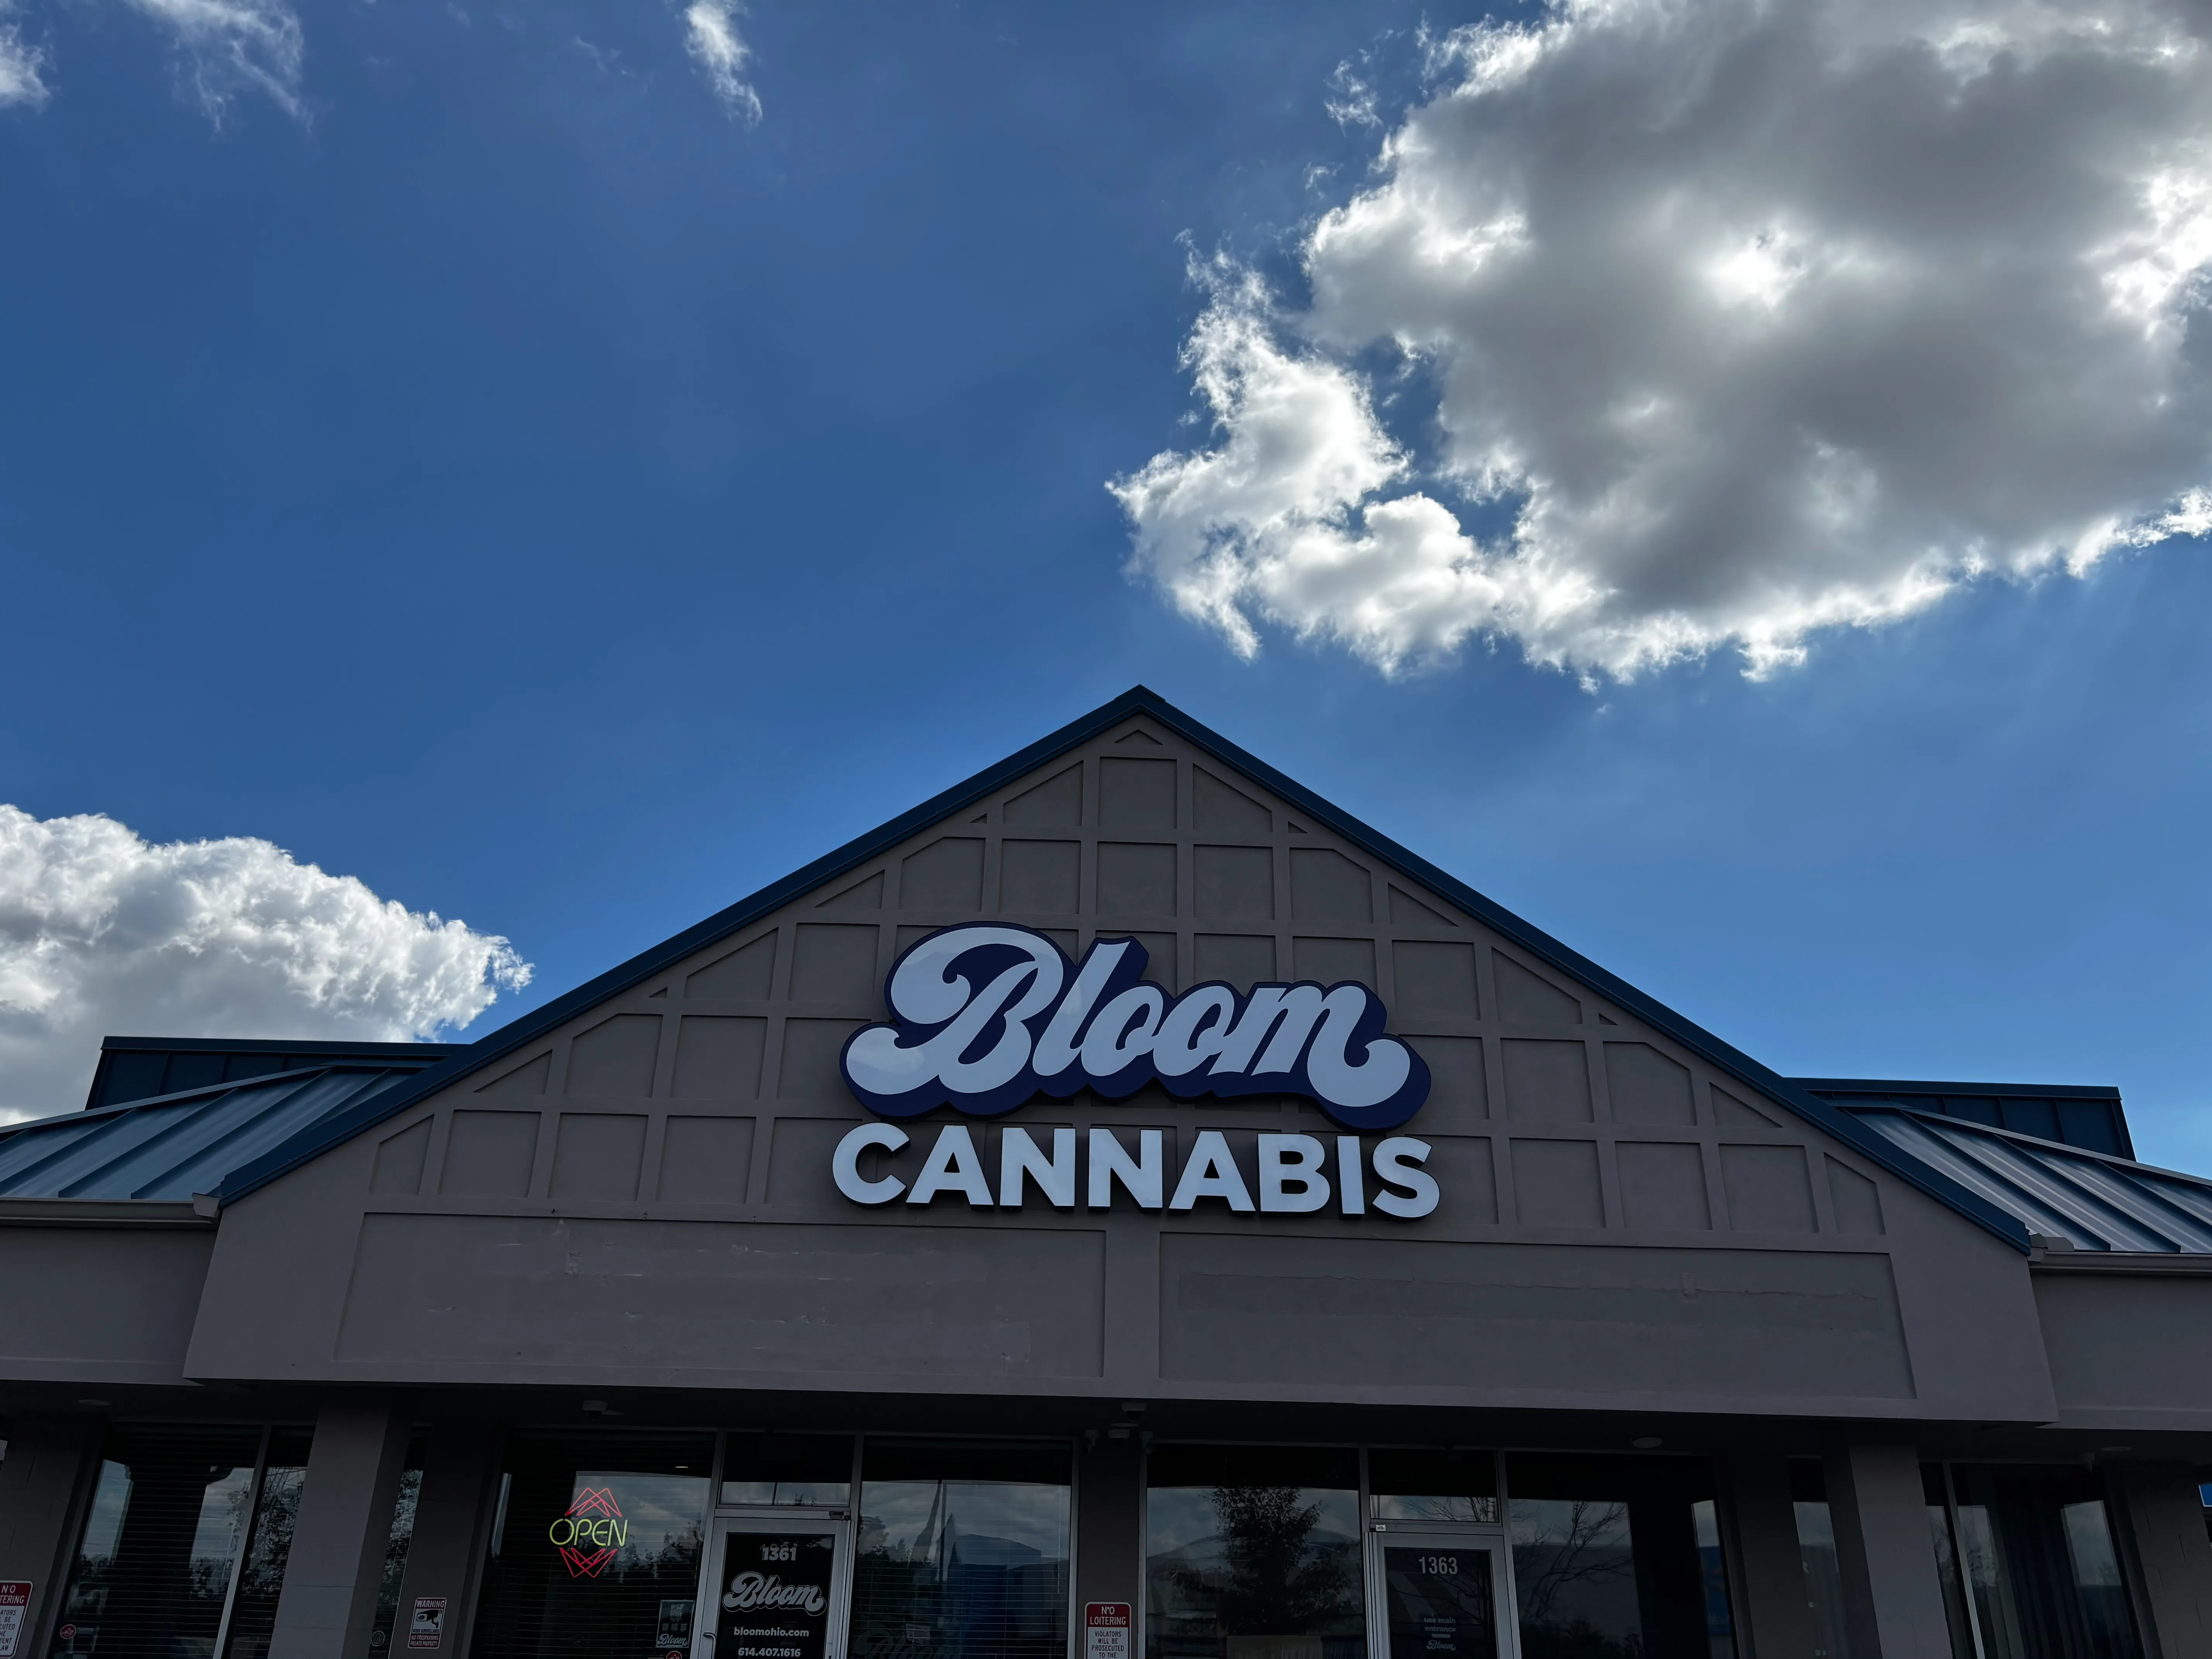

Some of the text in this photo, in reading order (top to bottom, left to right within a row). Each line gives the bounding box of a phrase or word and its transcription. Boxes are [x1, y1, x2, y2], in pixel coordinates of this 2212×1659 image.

[845, 926, 1411, 1108] Bloom
[831, 1122, 1440, 1222] CANNABIS
[549, 1518, 628, 1546] OPEN
[762, 1547, 797, 1561] 1361
[1419, 1556, 1458, 1575] 1363
[2, 1584, 16, 1594] NO
[723, 1572, 824, 1612] Bloom
[417, 1600, 445, 1608] WARNING
[1101, 1606, 1115, 1615] NO
[1090, 1616, 1127, 1625] LOITERING
[733, 1626, 810, 1637] bloomohio.com
[657, 1633, 688, 1646] Bloom
[1425, 1639, 1456, 1651] Bloom
[738, 1647, 801, 1657] 614.407.1616
